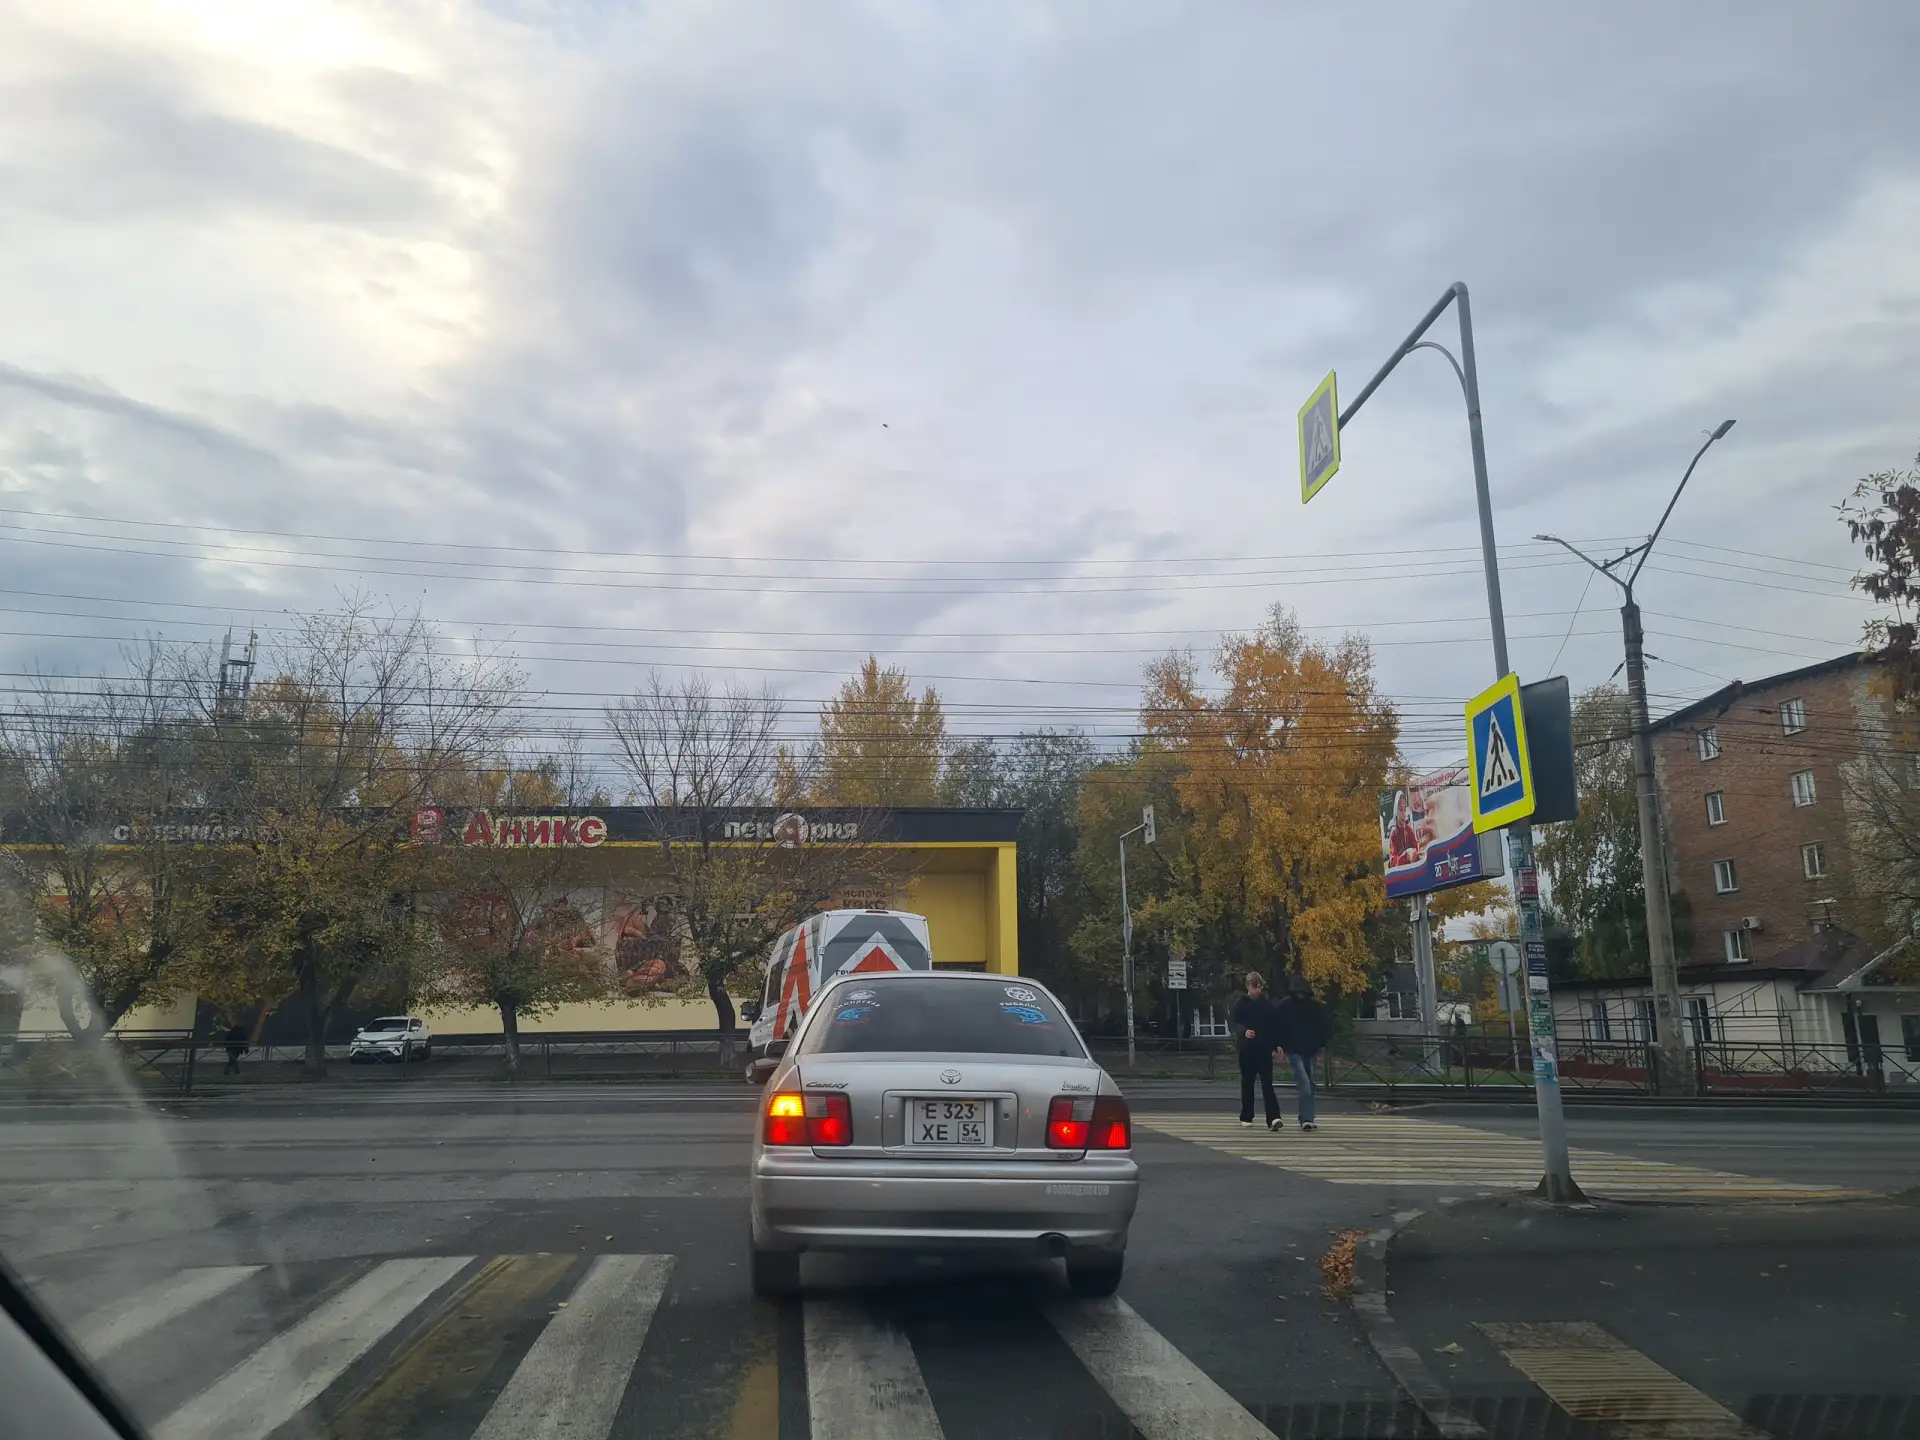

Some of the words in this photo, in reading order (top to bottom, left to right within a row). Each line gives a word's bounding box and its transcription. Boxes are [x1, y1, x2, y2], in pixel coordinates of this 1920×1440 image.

[463, 811, 606, 846] Аникс
[943, 1103, 974, 1119] 323
[962, 1123, 979, 1136] 54
